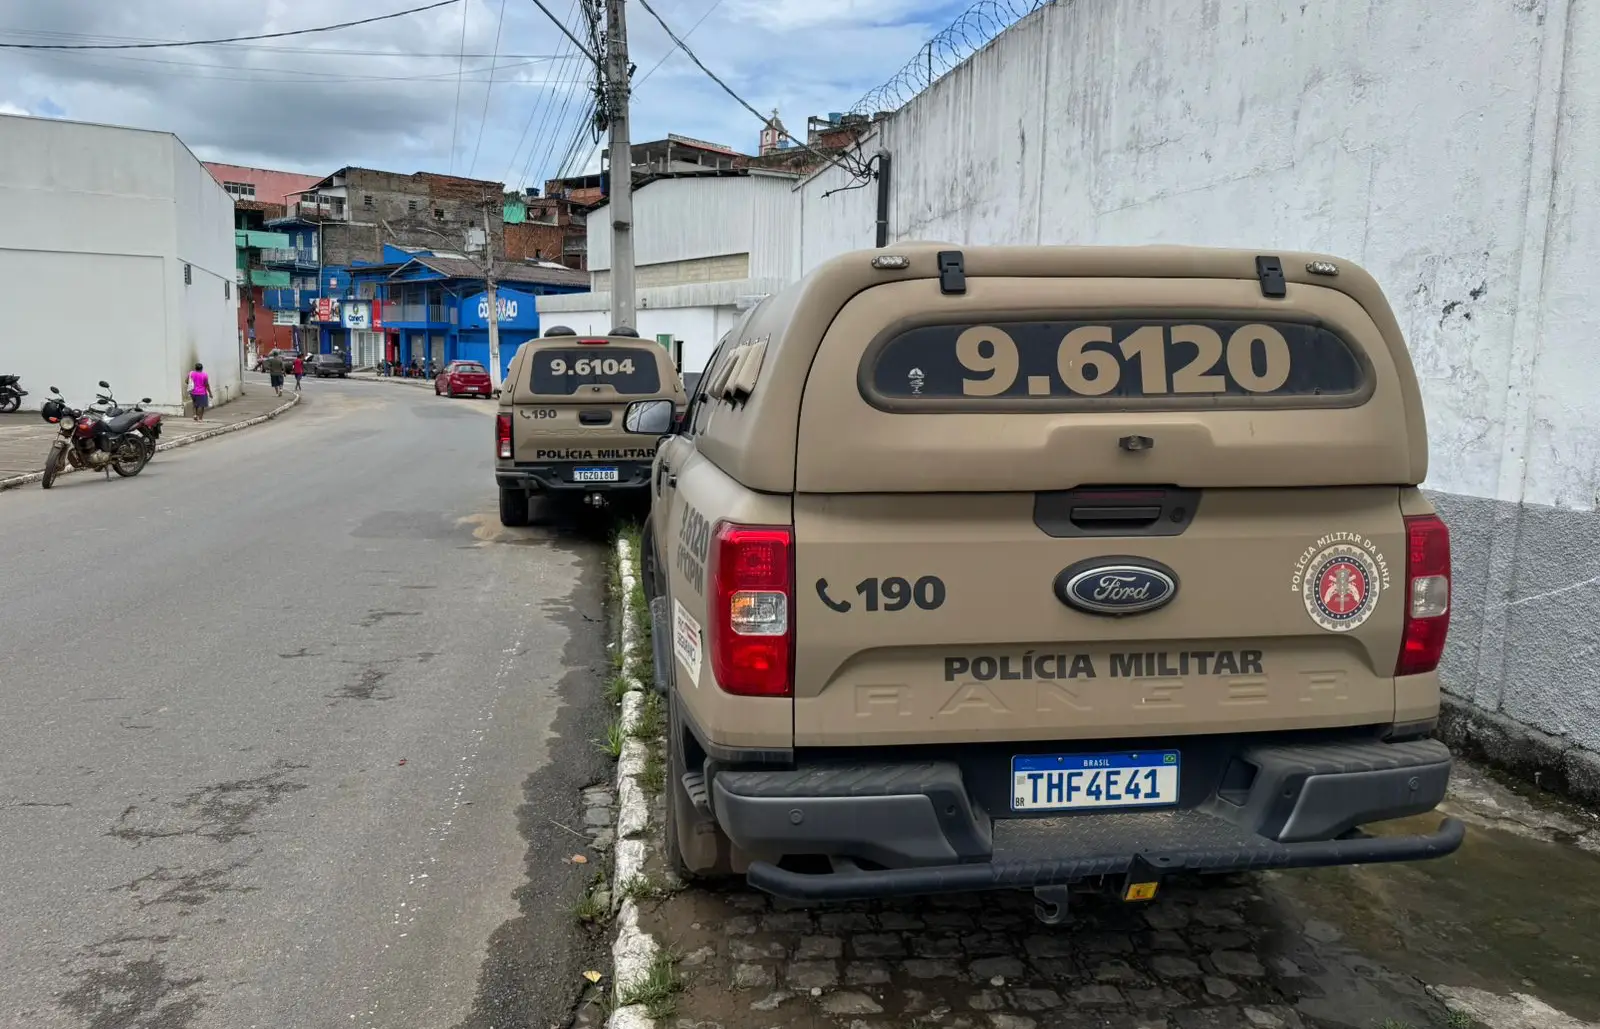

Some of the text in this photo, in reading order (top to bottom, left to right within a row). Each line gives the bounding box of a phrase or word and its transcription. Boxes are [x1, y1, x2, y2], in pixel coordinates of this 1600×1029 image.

[550, 358, 636, 376] 9.6104
[955, 323, 1292, 396] 9.6120
[531, 408, 558, 420] 190
[536, 446, 593, 460] POLÍCIA
[597, 447, 657, 459] MILITAR
[1292, 531, 1391, 592] POLÍCIA MILITAR DA BAHIA
[855, 574, 947, 613] 190
[1093, 575, 1151, 600] Ford
[944, 649, 1265, 681] POLÍCIA MILITAR
[1083, 758, 1111, 767] BRASIL
[1027, 769, 1161, 804] THF4E41
[1015, 797, 1026, 807] BR
